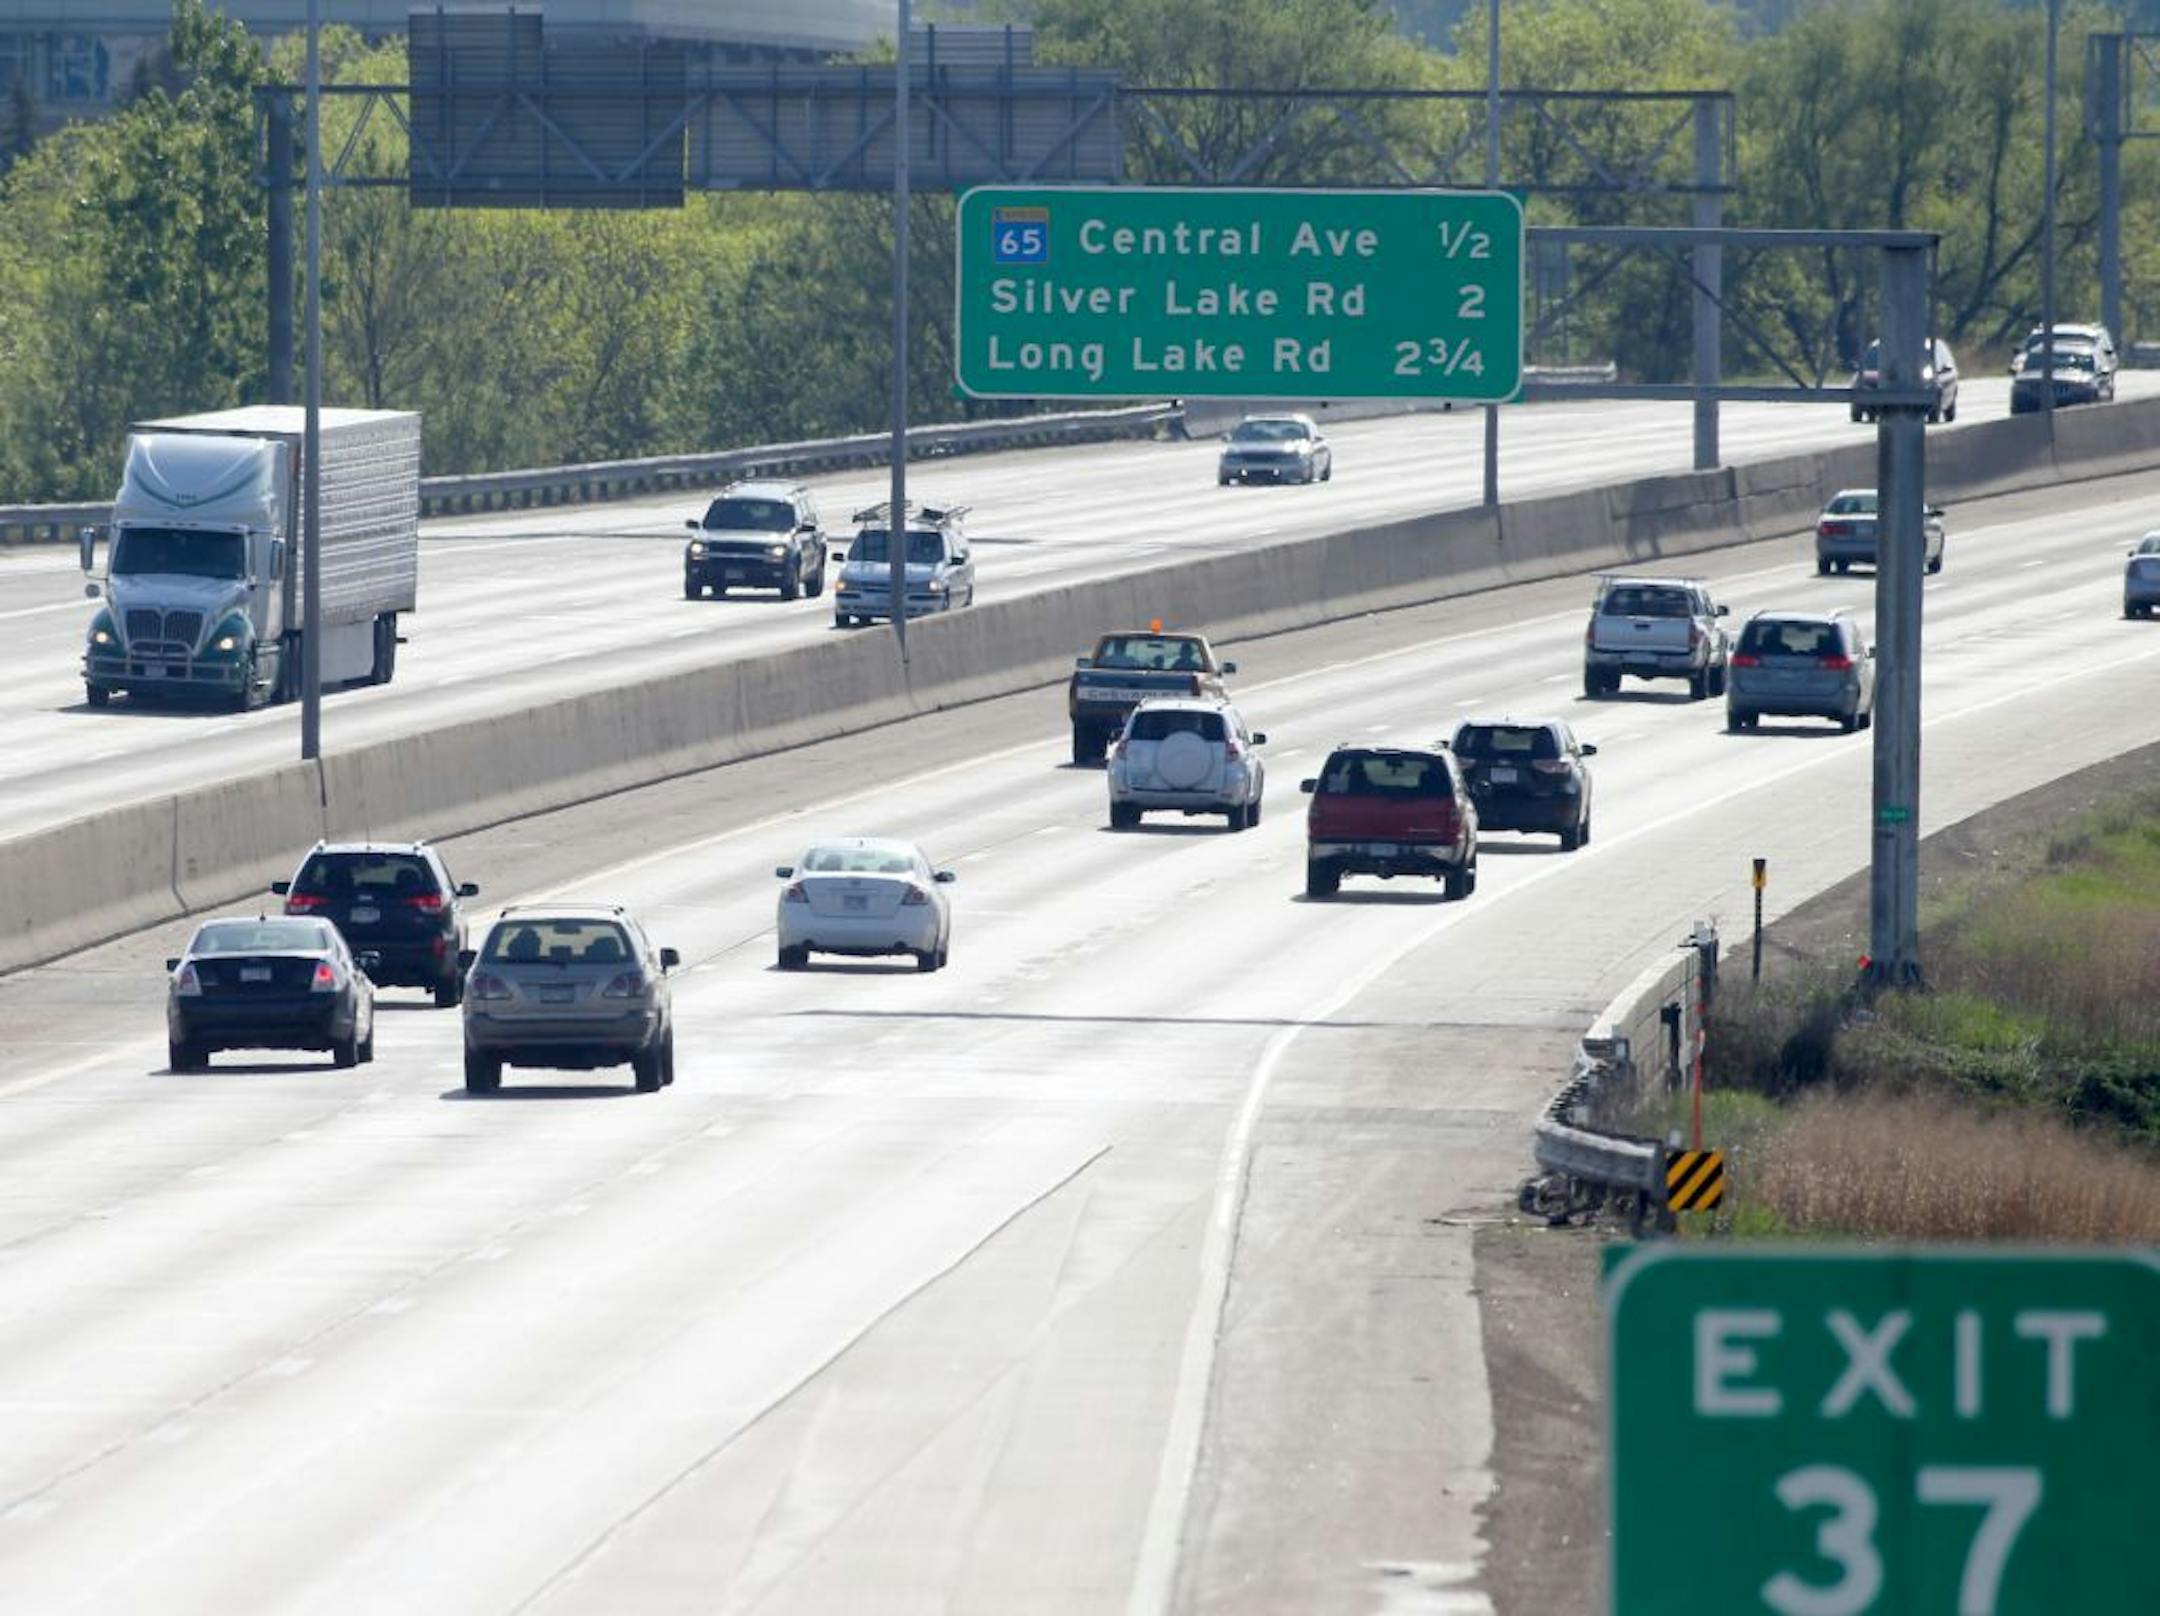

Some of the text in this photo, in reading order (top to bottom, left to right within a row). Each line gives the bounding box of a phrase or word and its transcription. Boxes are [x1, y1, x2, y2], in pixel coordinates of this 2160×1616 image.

[1000, 228, 1042, 255] 65
[1080, 219, 1260, 257] Central
[1291, 223, 1377, 258] Ave
[992, 279, 1486, 319] Silver Lake Rd 2
[989, 336, 1104, 382] Long
[1134, 337, 1245, 372] Lake
[1274, 338, 1331, 373] Rd
[1693, 1309, 2107, 1418] EXIT
[1762, 1464, 2043, 1616] 37
